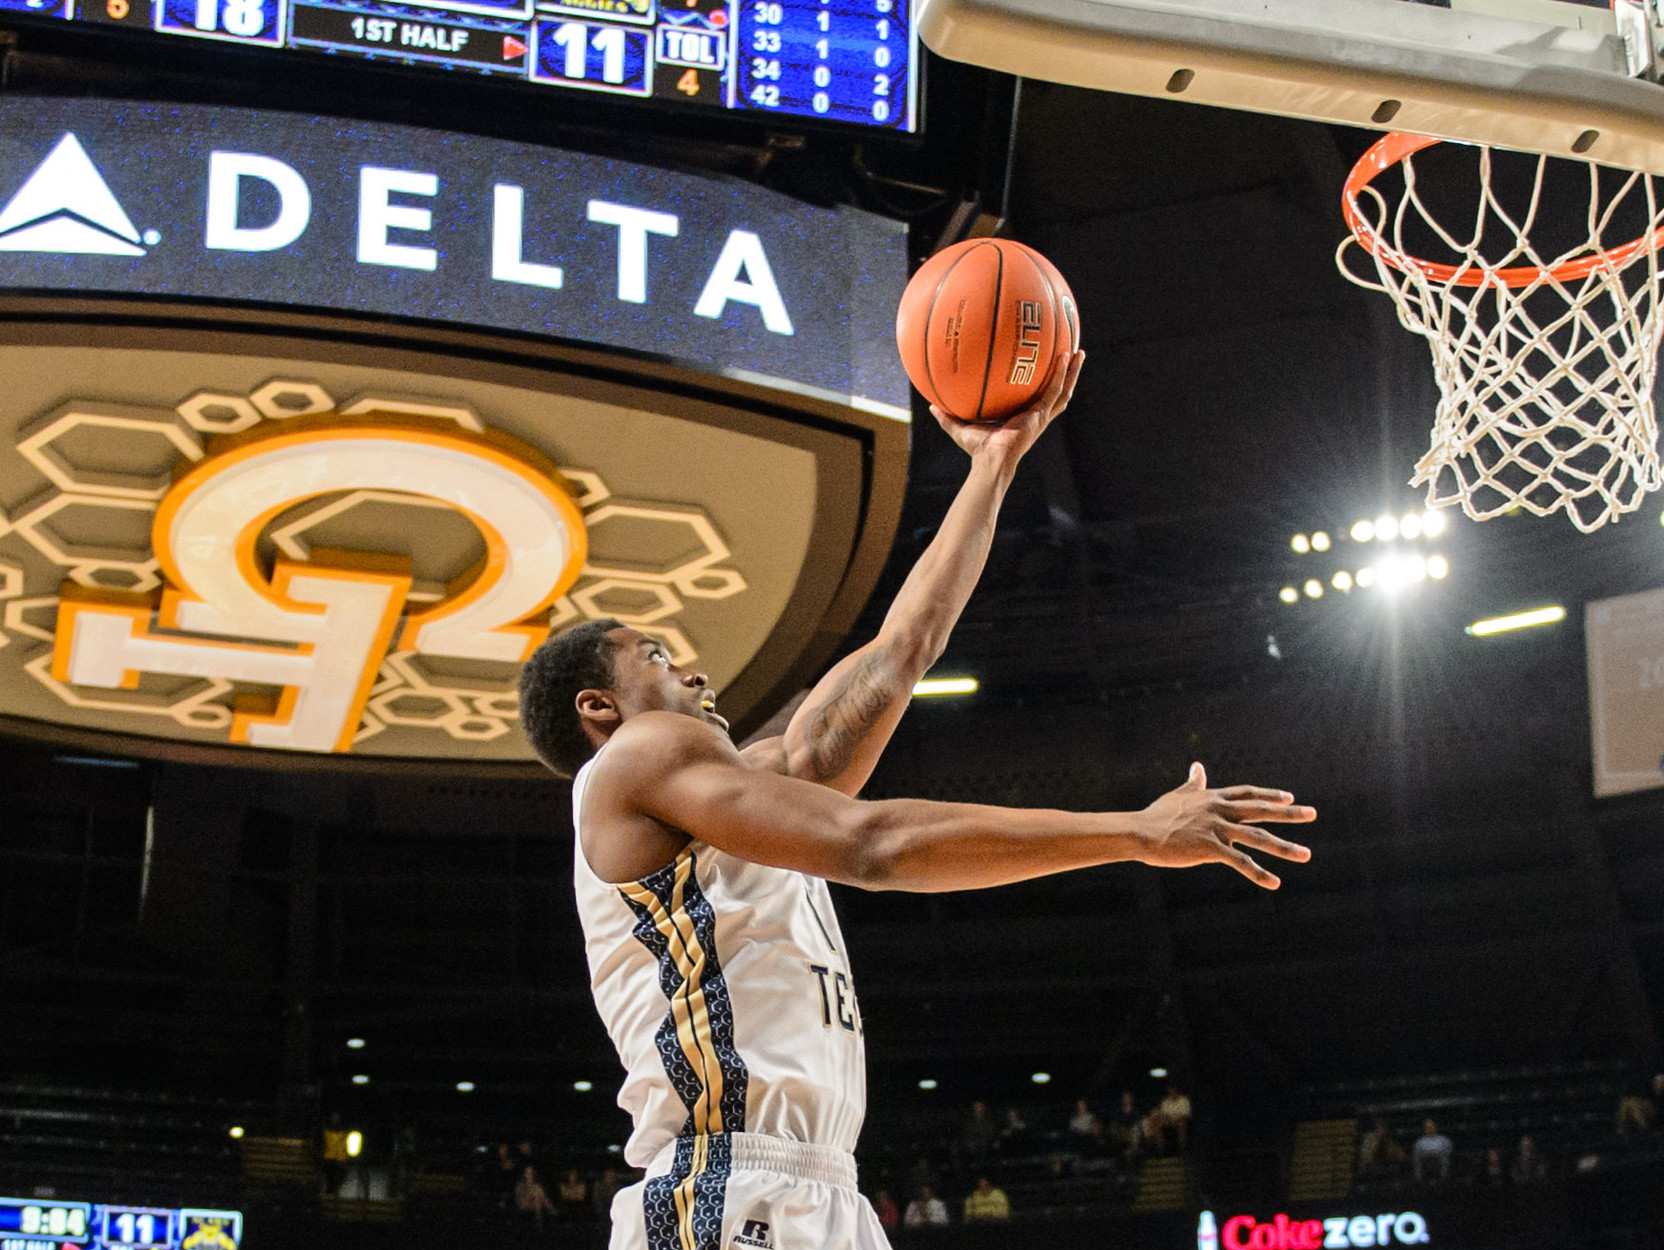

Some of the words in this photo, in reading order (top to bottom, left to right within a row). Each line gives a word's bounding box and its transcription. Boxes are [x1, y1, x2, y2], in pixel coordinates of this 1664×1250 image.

[754, 2, 783, 25] 30
[816, 11, 830, 32] 1
[351, 18, 397, 42] 1ST
[401, 24, 469, 51] HALF
[876, 19, 890, 40] 1
[666, 31, 714, 63] TOL
[753, 30, 782, 53] 33
[816, 39, 829, 60] 1
[553, 23, 626, 84] 11
[874, 46, 890, 68] 0
[751, 57, 782, 81] 34
[813, 66, 830, 88] 0
[677, 69, 699, 96] 4
[873, 74, 889, 96] 2
[750, 84, 780, 107] 42
[812, 92, 830, 114] 0
[872, 100, 889, 121] 0
[205, 150, 796, 336] DELTA
[1010, 301, 1042, 386] ELITE
[808, 963, 864, 1036] TE
[116, 1213, 154, 1244] 11
[1323, 1211, 1427, 1250] zero
[733, 1235, 775, 1250] RUSSELL
